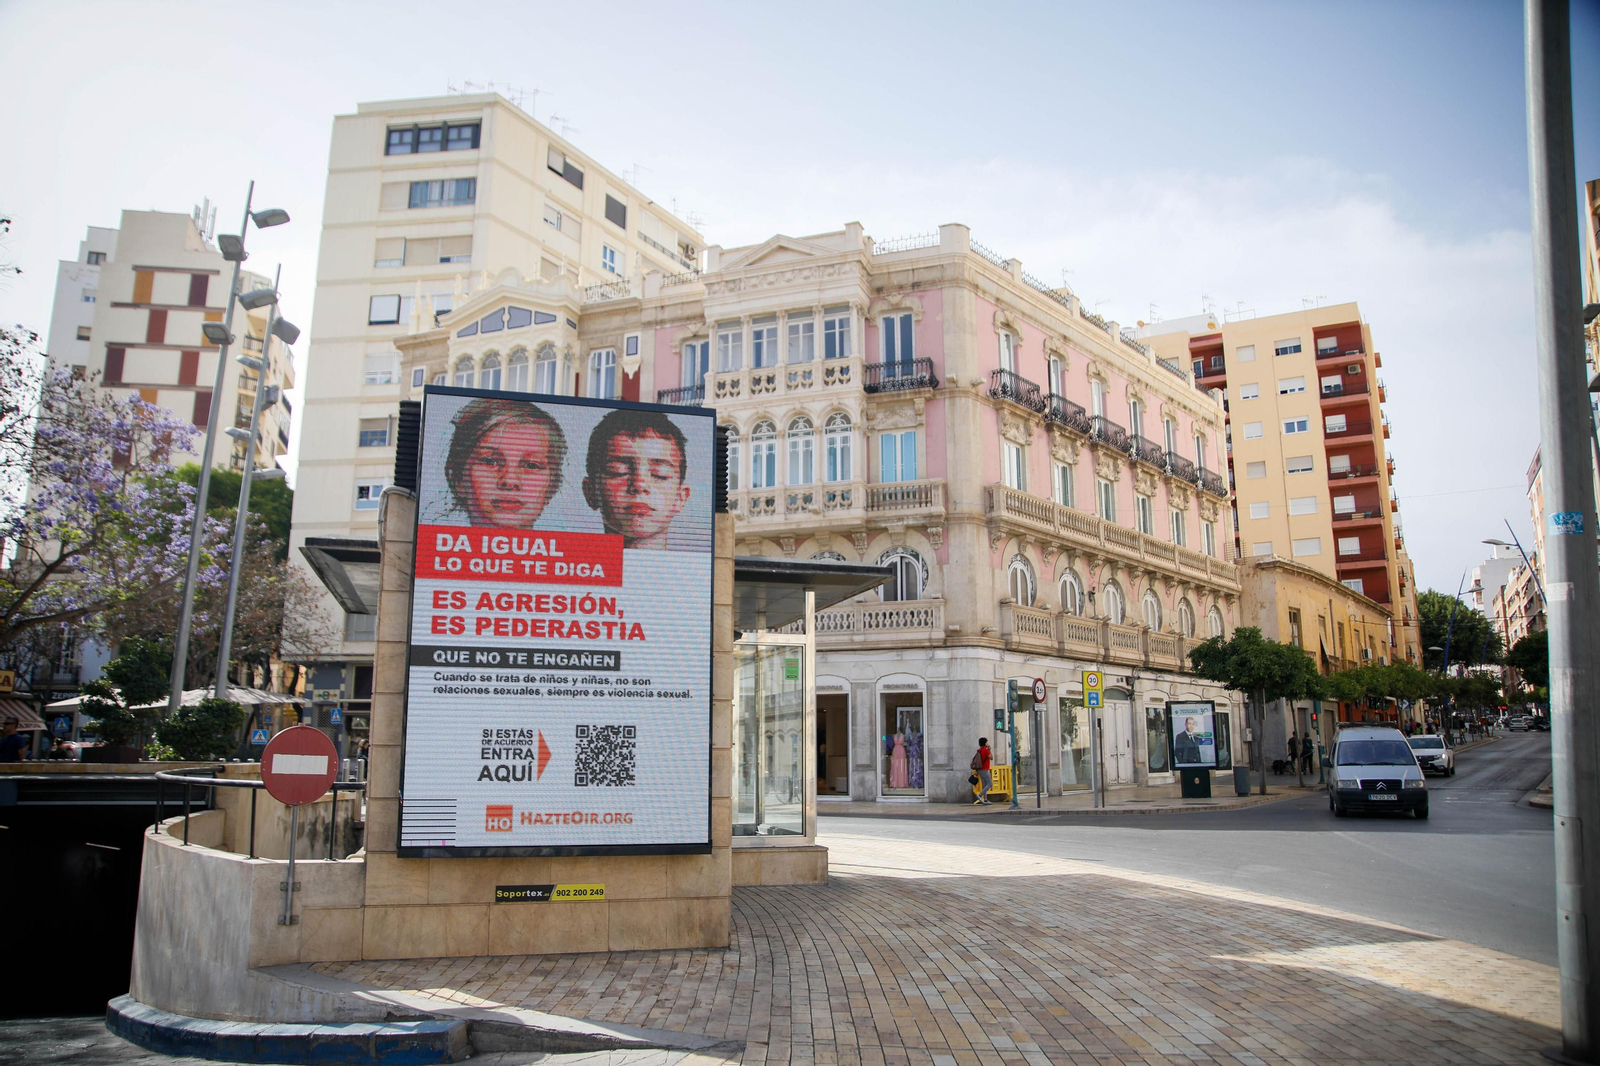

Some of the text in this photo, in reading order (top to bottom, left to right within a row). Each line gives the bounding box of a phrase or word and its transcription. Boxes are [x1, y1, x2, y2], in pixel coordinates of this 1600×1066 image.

[436, 533, 564, 557] DA IGUAL
[434, 556, 605, 578] LO QUE TE DIGA
[432, 590, 624, 619] ES AGRESIÓN,
[431, 615, 466, 635] ES
[433, 650, 616, 668] QUE NO TE ENGAÑEN
[433, 671, 652, 687] Cuando se trata de niños y niñas, no son
[433, 685, 694, 700] relaciones sexuales, siempre es violencia sexual.
[482, 728, 534, 739] SI ESTÁS
[480, 747, 535, 760] ENTRA
[477, 760, 533, 783] AQUÍ
[487, 817, 511, 830] HO
[556, 889, 571, 897] 902
[573, 889, 588, 897] 200
[589, 888, 605, 896] 249
